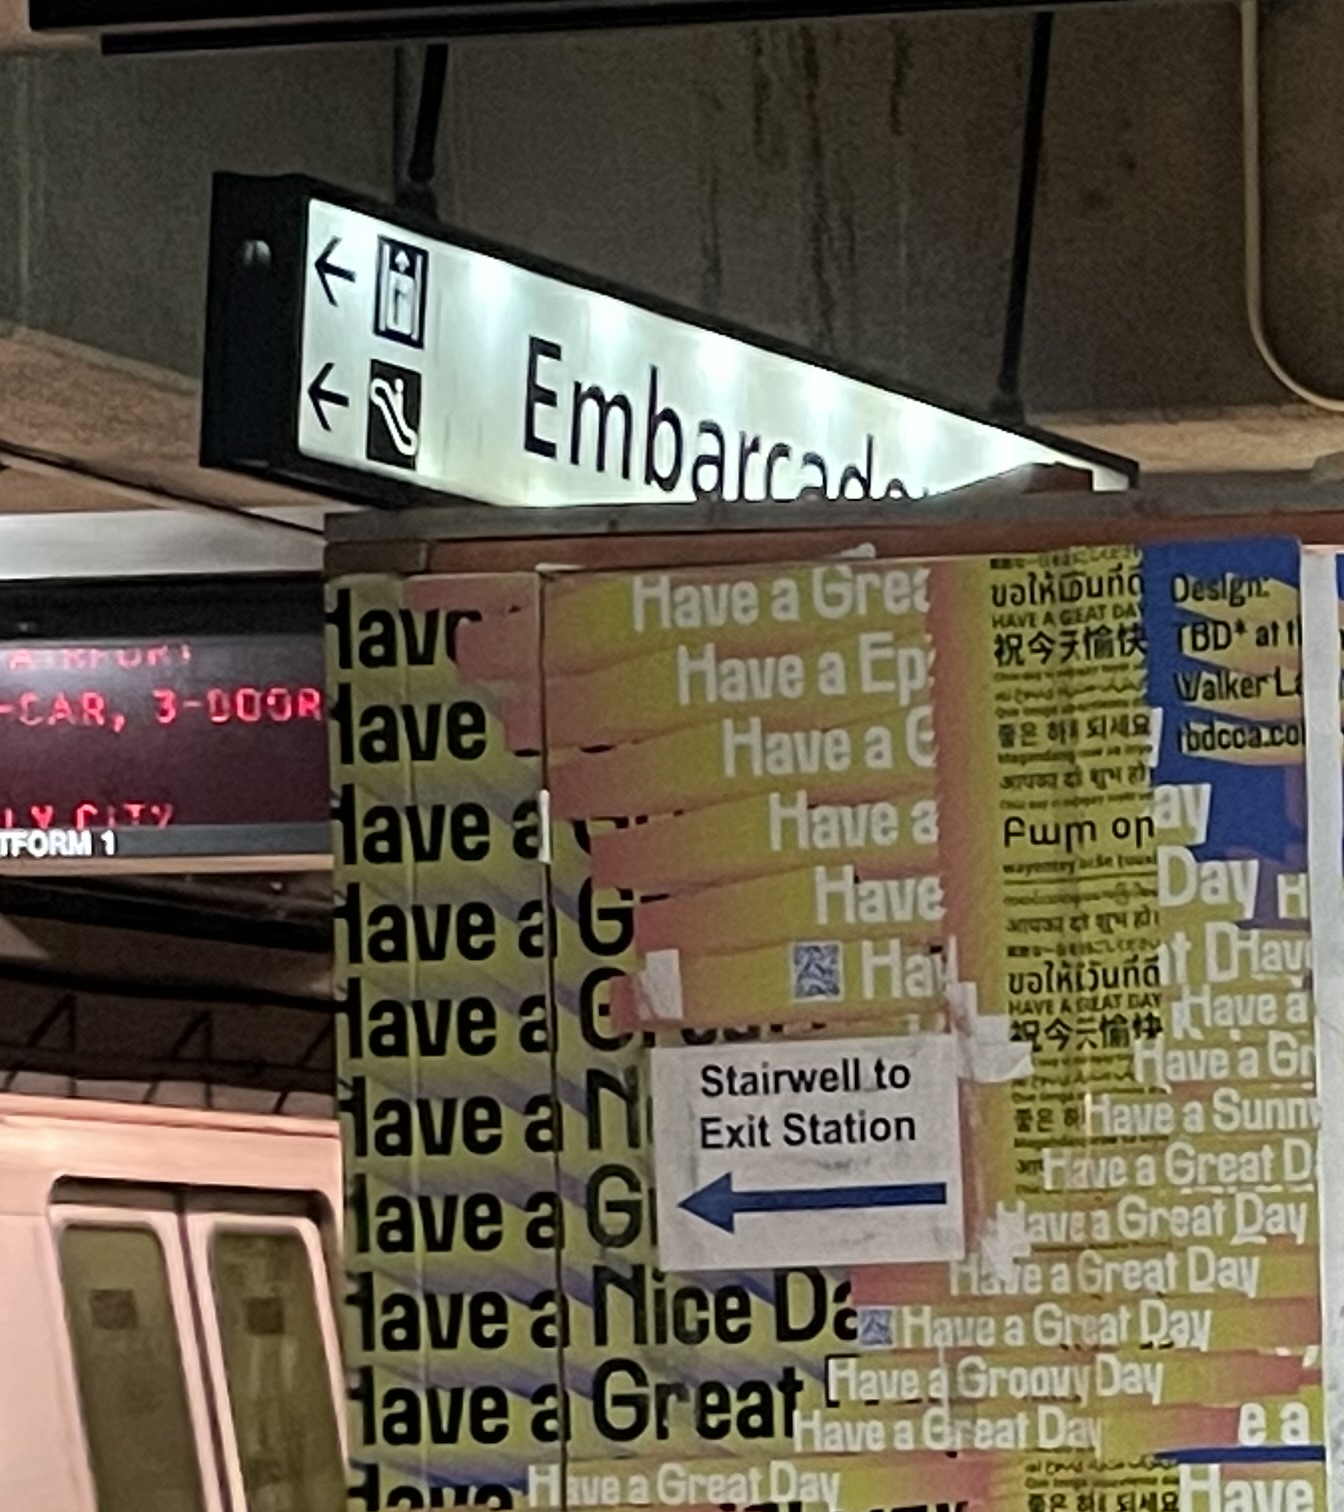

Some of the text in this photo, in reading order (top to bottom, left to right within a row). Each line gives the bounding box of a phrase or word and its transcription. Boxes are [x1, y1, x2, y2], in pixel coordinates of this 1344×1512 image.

[101, 830, 116, 855] 1
[700, 1057, 911, 1098] Stairwell to
[700, 1109, 916, 1149] Exit Station
[1183, 1102, 1206, 1133] a
[531, 1294, 569, 1349] a
[592, 1266, 751, 1347] Nice
[774, 1267, 859, 1343] Da
[902, 1300, 1214, 1352] Have a Great Day
[828, 1354, 1165, 1407] Have a Groovy Day
